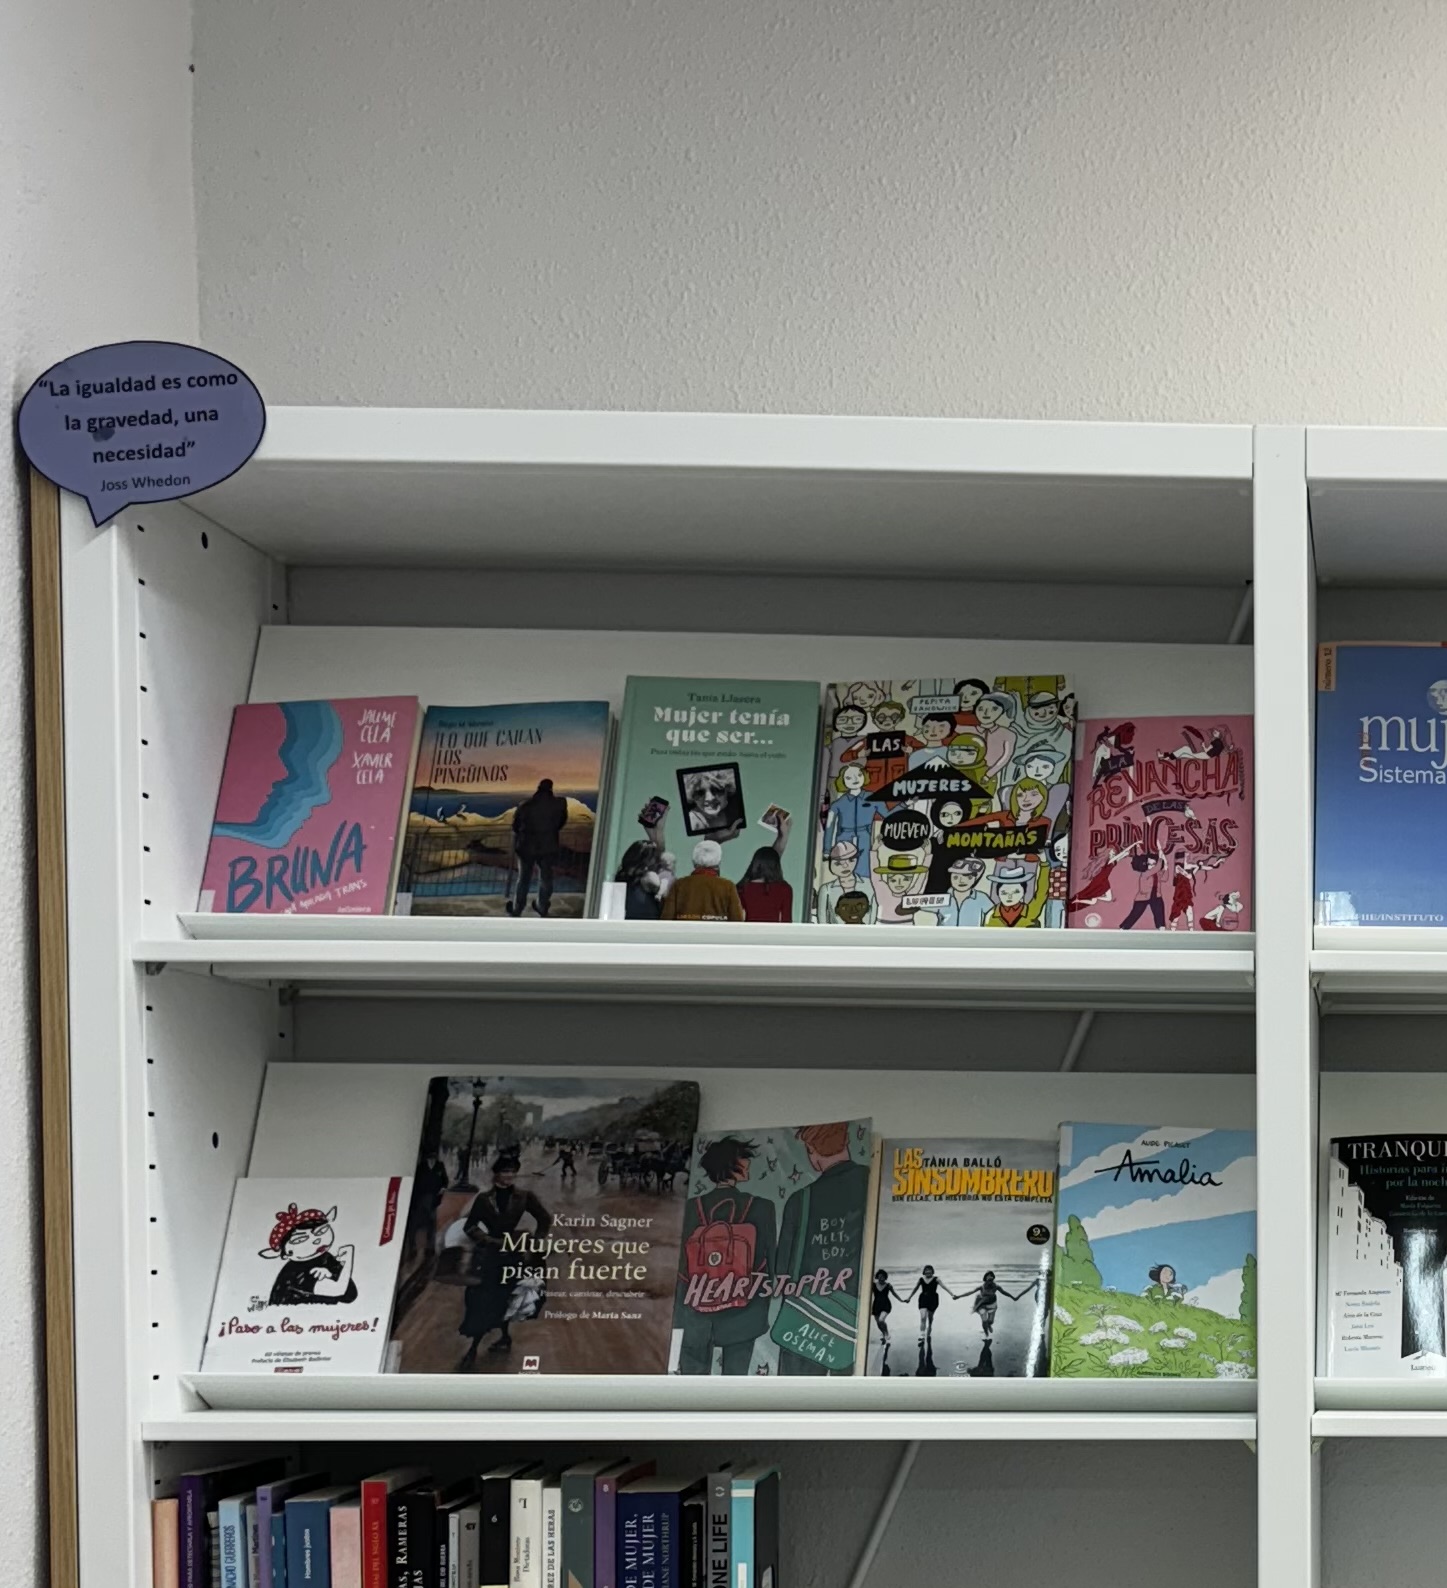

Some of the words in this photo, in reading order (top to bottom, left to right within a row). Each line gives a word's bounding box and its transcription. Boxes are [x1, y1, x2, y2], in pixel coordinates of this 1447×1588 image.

[76, 376, 156, 399] igualdad
[162, 377, 181, 390] es
[187, 373, 238, 387] como
[65, 414, 81, 431] la
[87, 410, 179, 432] gravedad,
[185, 408, 218, 423] una
[101, 478, 127, 492] Joss
[132, 474, 190, 489] Whedon
[654, 706, 723, 727] Mujer
[730, 709, 790, 726] tenía
[666, 728, 710, 747] que
[716, 730, 773, 744] ser...
[872, 738, 900, 752] LAS
[434, 764, 508, 784] PINGÜINOS
[1109, 757, 1127, 769] LA
[1359, 757, 1447, 784] Sistema
[893, 779, 972, 797] MUJERES
[1088, 752, 1238, 827] REVANCHA
[885, 822, 929, 839] MUEVEN
[947, 827, 1038, 849] MONTAÑAS
[1089, 815, 1238, 859] PRINCESAS
[226, 820, 367, 913] BRUNA
[894, 1148, 923, 1170] LAS
[1095, 1149, 1223, 1187] Amalia
[552, 1213, 596, 1228] Karin
[601, 1215, 653, 1231] Sagner
[820, 1217, 846, 1231] BOY
[501, 1232, 604, 1259] Mujeres
[611, 1239, 649, 1260] que
[501, 1262, 559, 1284] pisan
[568, 1258, 647, 1281] fuerte
[684, 1268, 852, 1307] HEARTSTOPPER
[218, 1317, 263, 1337] ¡Paso
[266, 1325, 277, 1333] a
[281, 1317, 303, 1334] las
[308, 1317, 379, 1340] mujeres!
[798, 1324, 835, 1348] ALICE
[783, 1331, 835, 1363] OSEMAN
[223, 1525, 236, 1564] GUERREROS
[396, 1505, 408, 1565] RAMERAS
[625, 1513, 640, 1570] MUJER,
[642, 1513, 657, 1565] MUJER
[712, 1514, 727, 1553] LIFE
[225, 1566, 237, 1588] NACHO
